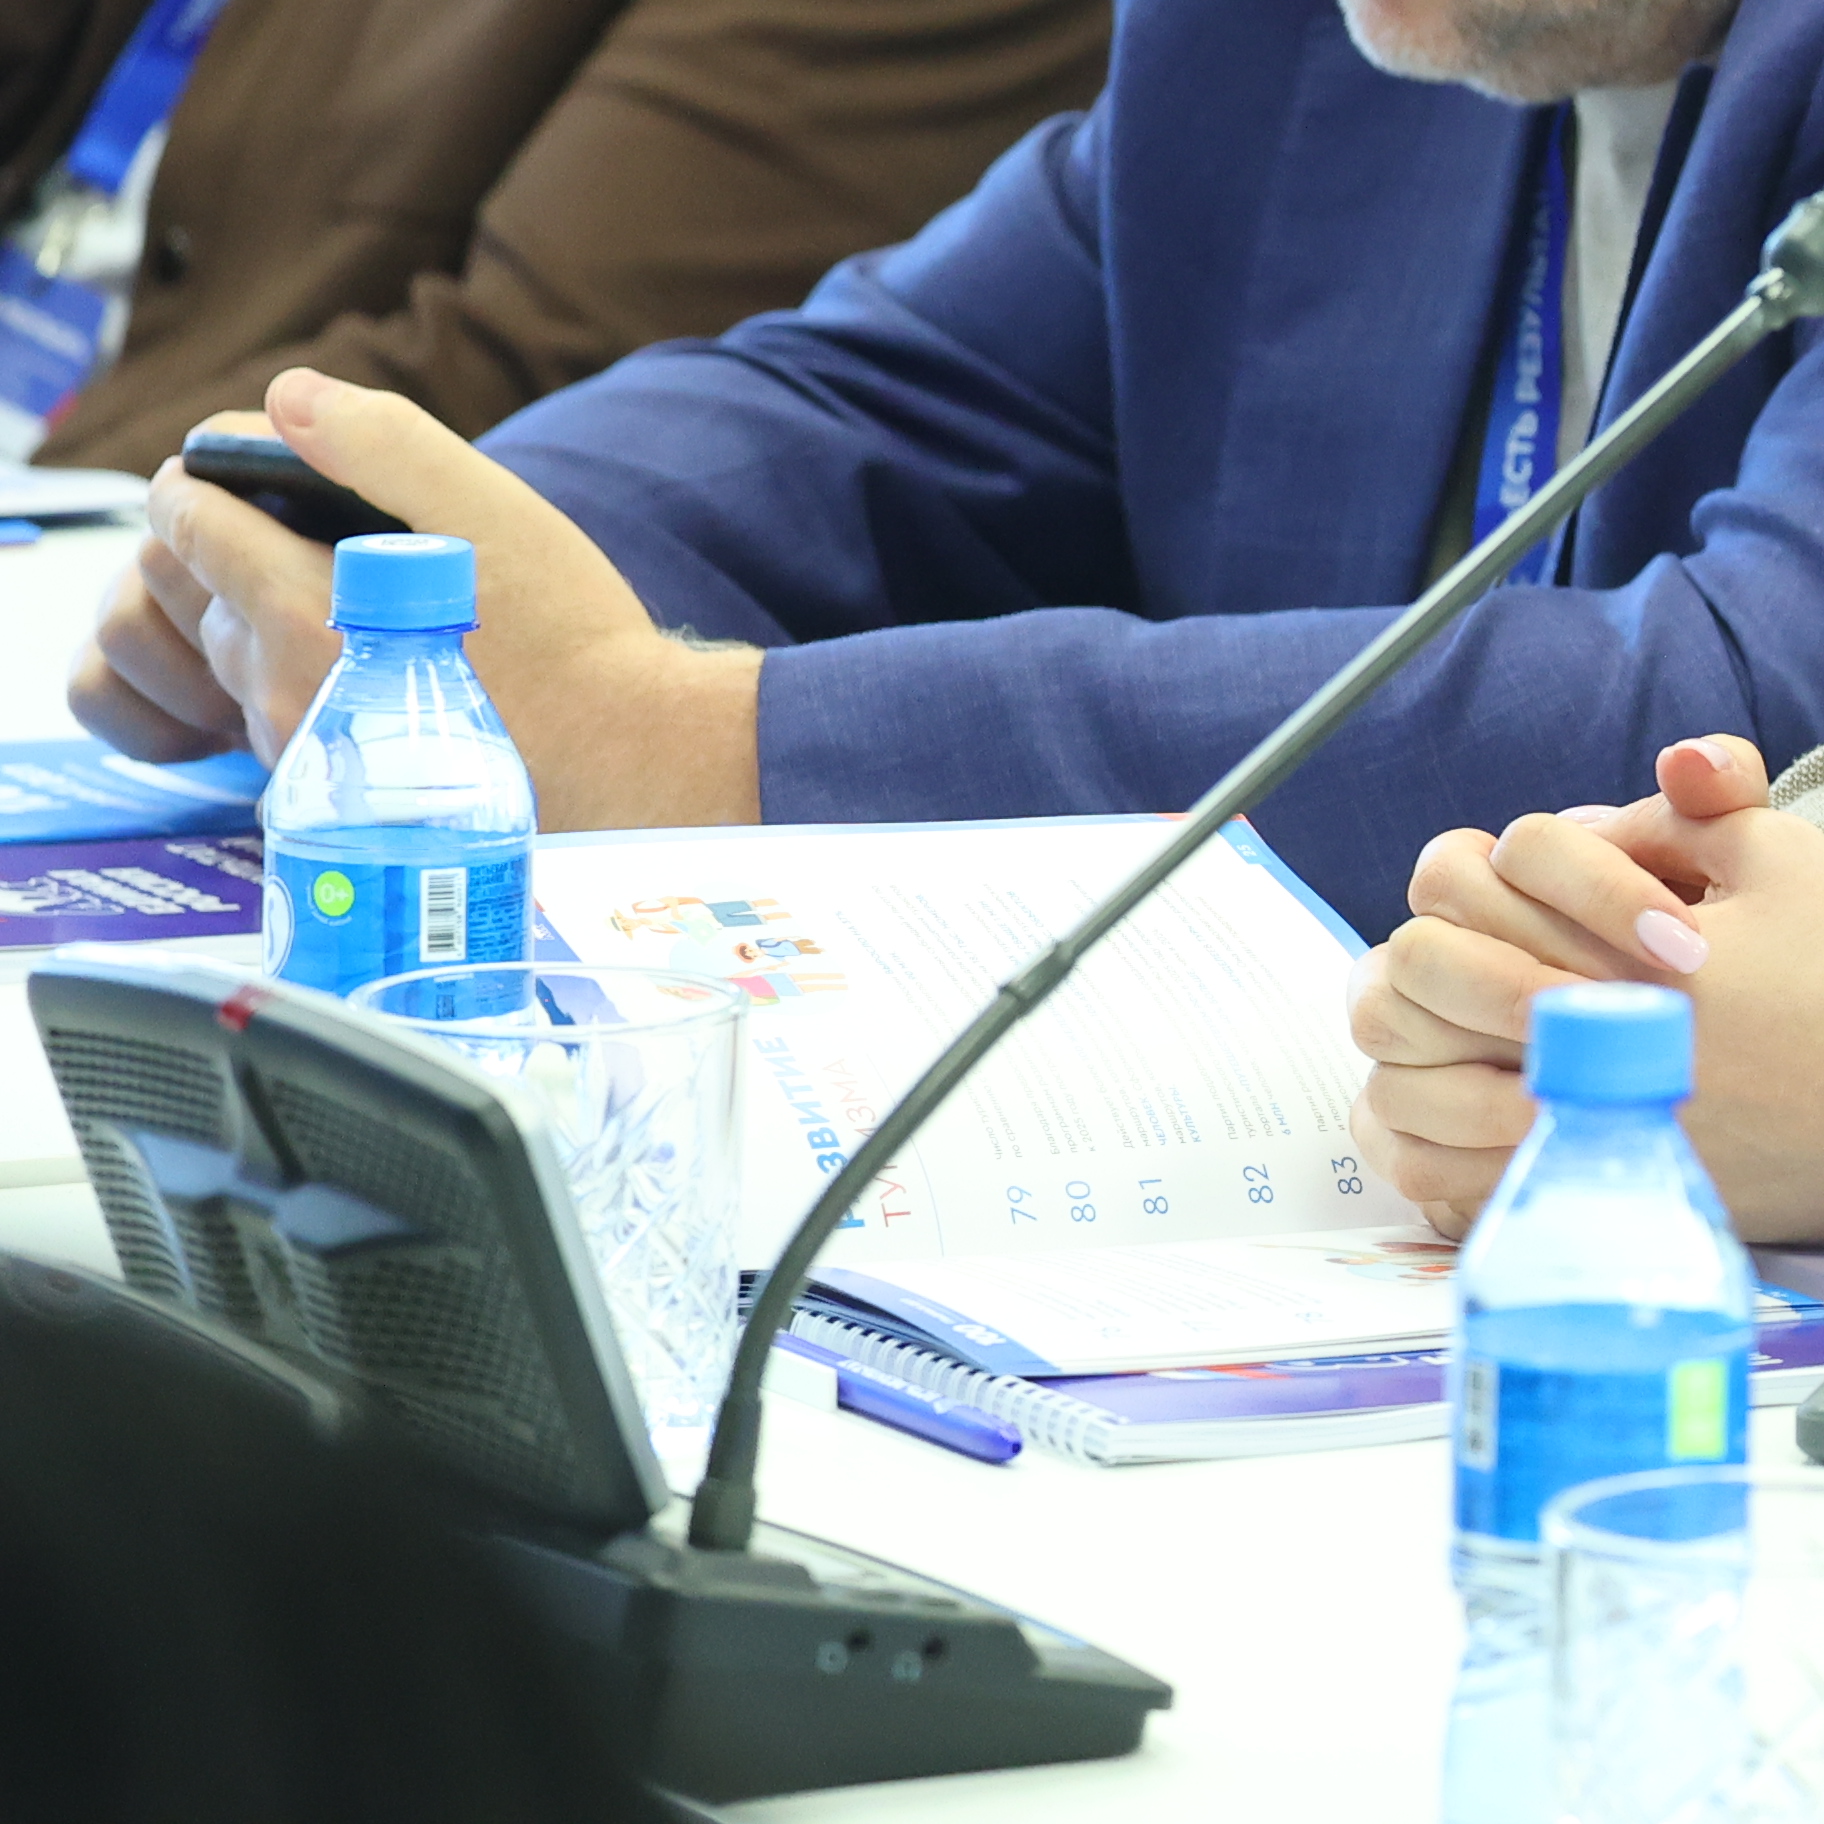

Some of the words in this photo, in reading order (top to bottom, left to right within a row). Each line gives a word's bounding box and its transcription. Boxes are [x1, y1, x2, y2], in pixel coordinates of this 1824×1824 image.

[1236, 843, 1258, 858] 25
[320, 883, 350, 904] 0+
[1214, 1102, 1240, 1139] Партия
[1268, 1102, 1288, 1125] МЛН
[1303, 1095, 1329, 1131] Партия
[753, 1037, 866, 1230] РЗВИТИЕ
[1244, 1163, 1275, 1204] 82
[1332, 1155, 1363, 1194] 83
[1007, 1184, 1038, 1224] 79
[1066, 1180, 1096, 1223] 80
[1138, 1177, 1168, 1215] 81
